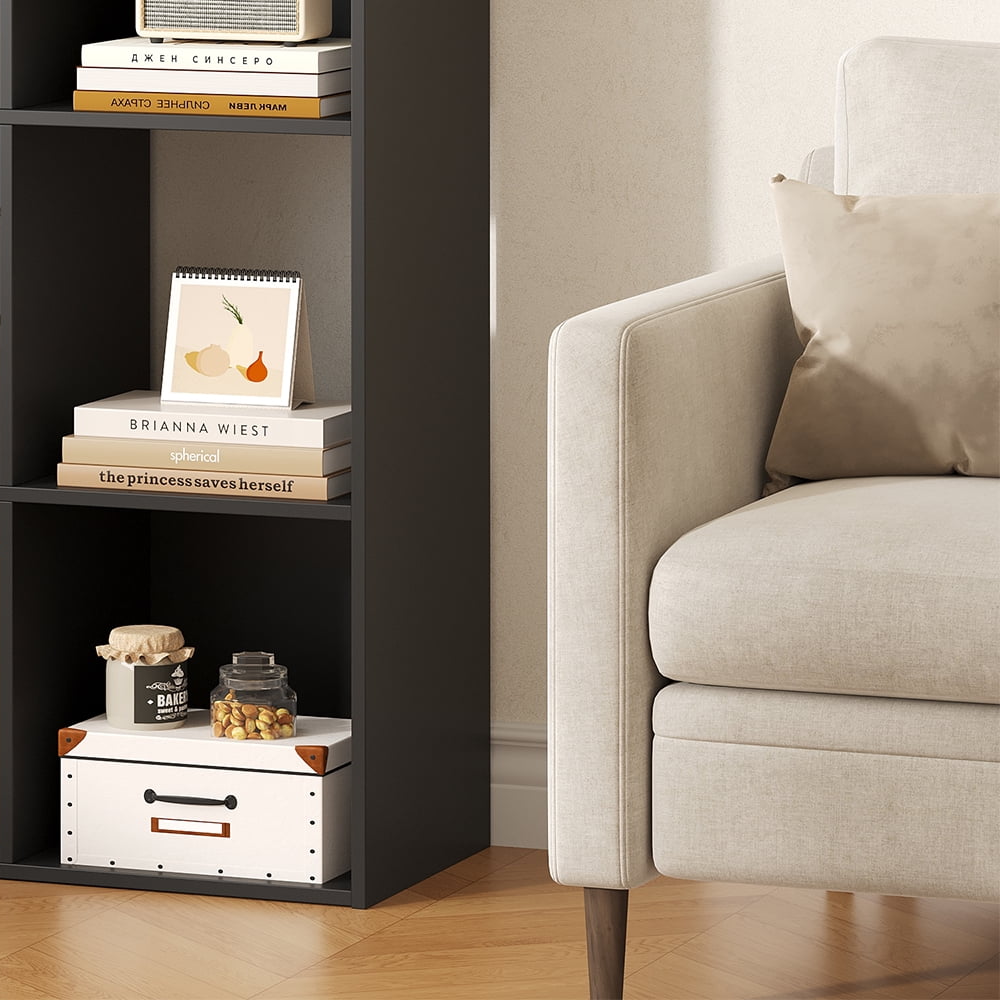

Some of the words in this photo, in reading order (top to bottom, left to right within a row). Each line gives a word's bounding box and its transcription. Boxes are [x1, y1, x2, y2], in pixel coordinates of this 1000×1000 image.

[131, 53, 178, 64] ДЖЕН
[192, 55, 274, 66] СИНСЕРО
[130, 418, 209, 434] BRIANNA
[218, 423, 270, 437] WIEST
[170, 448, 220, 465] spherical
[99, 471, 125, 483] the
[127, 472, 193, 488] princess
[194, 478, 237, 490] saves
[239, 478, 294, 493] herself
